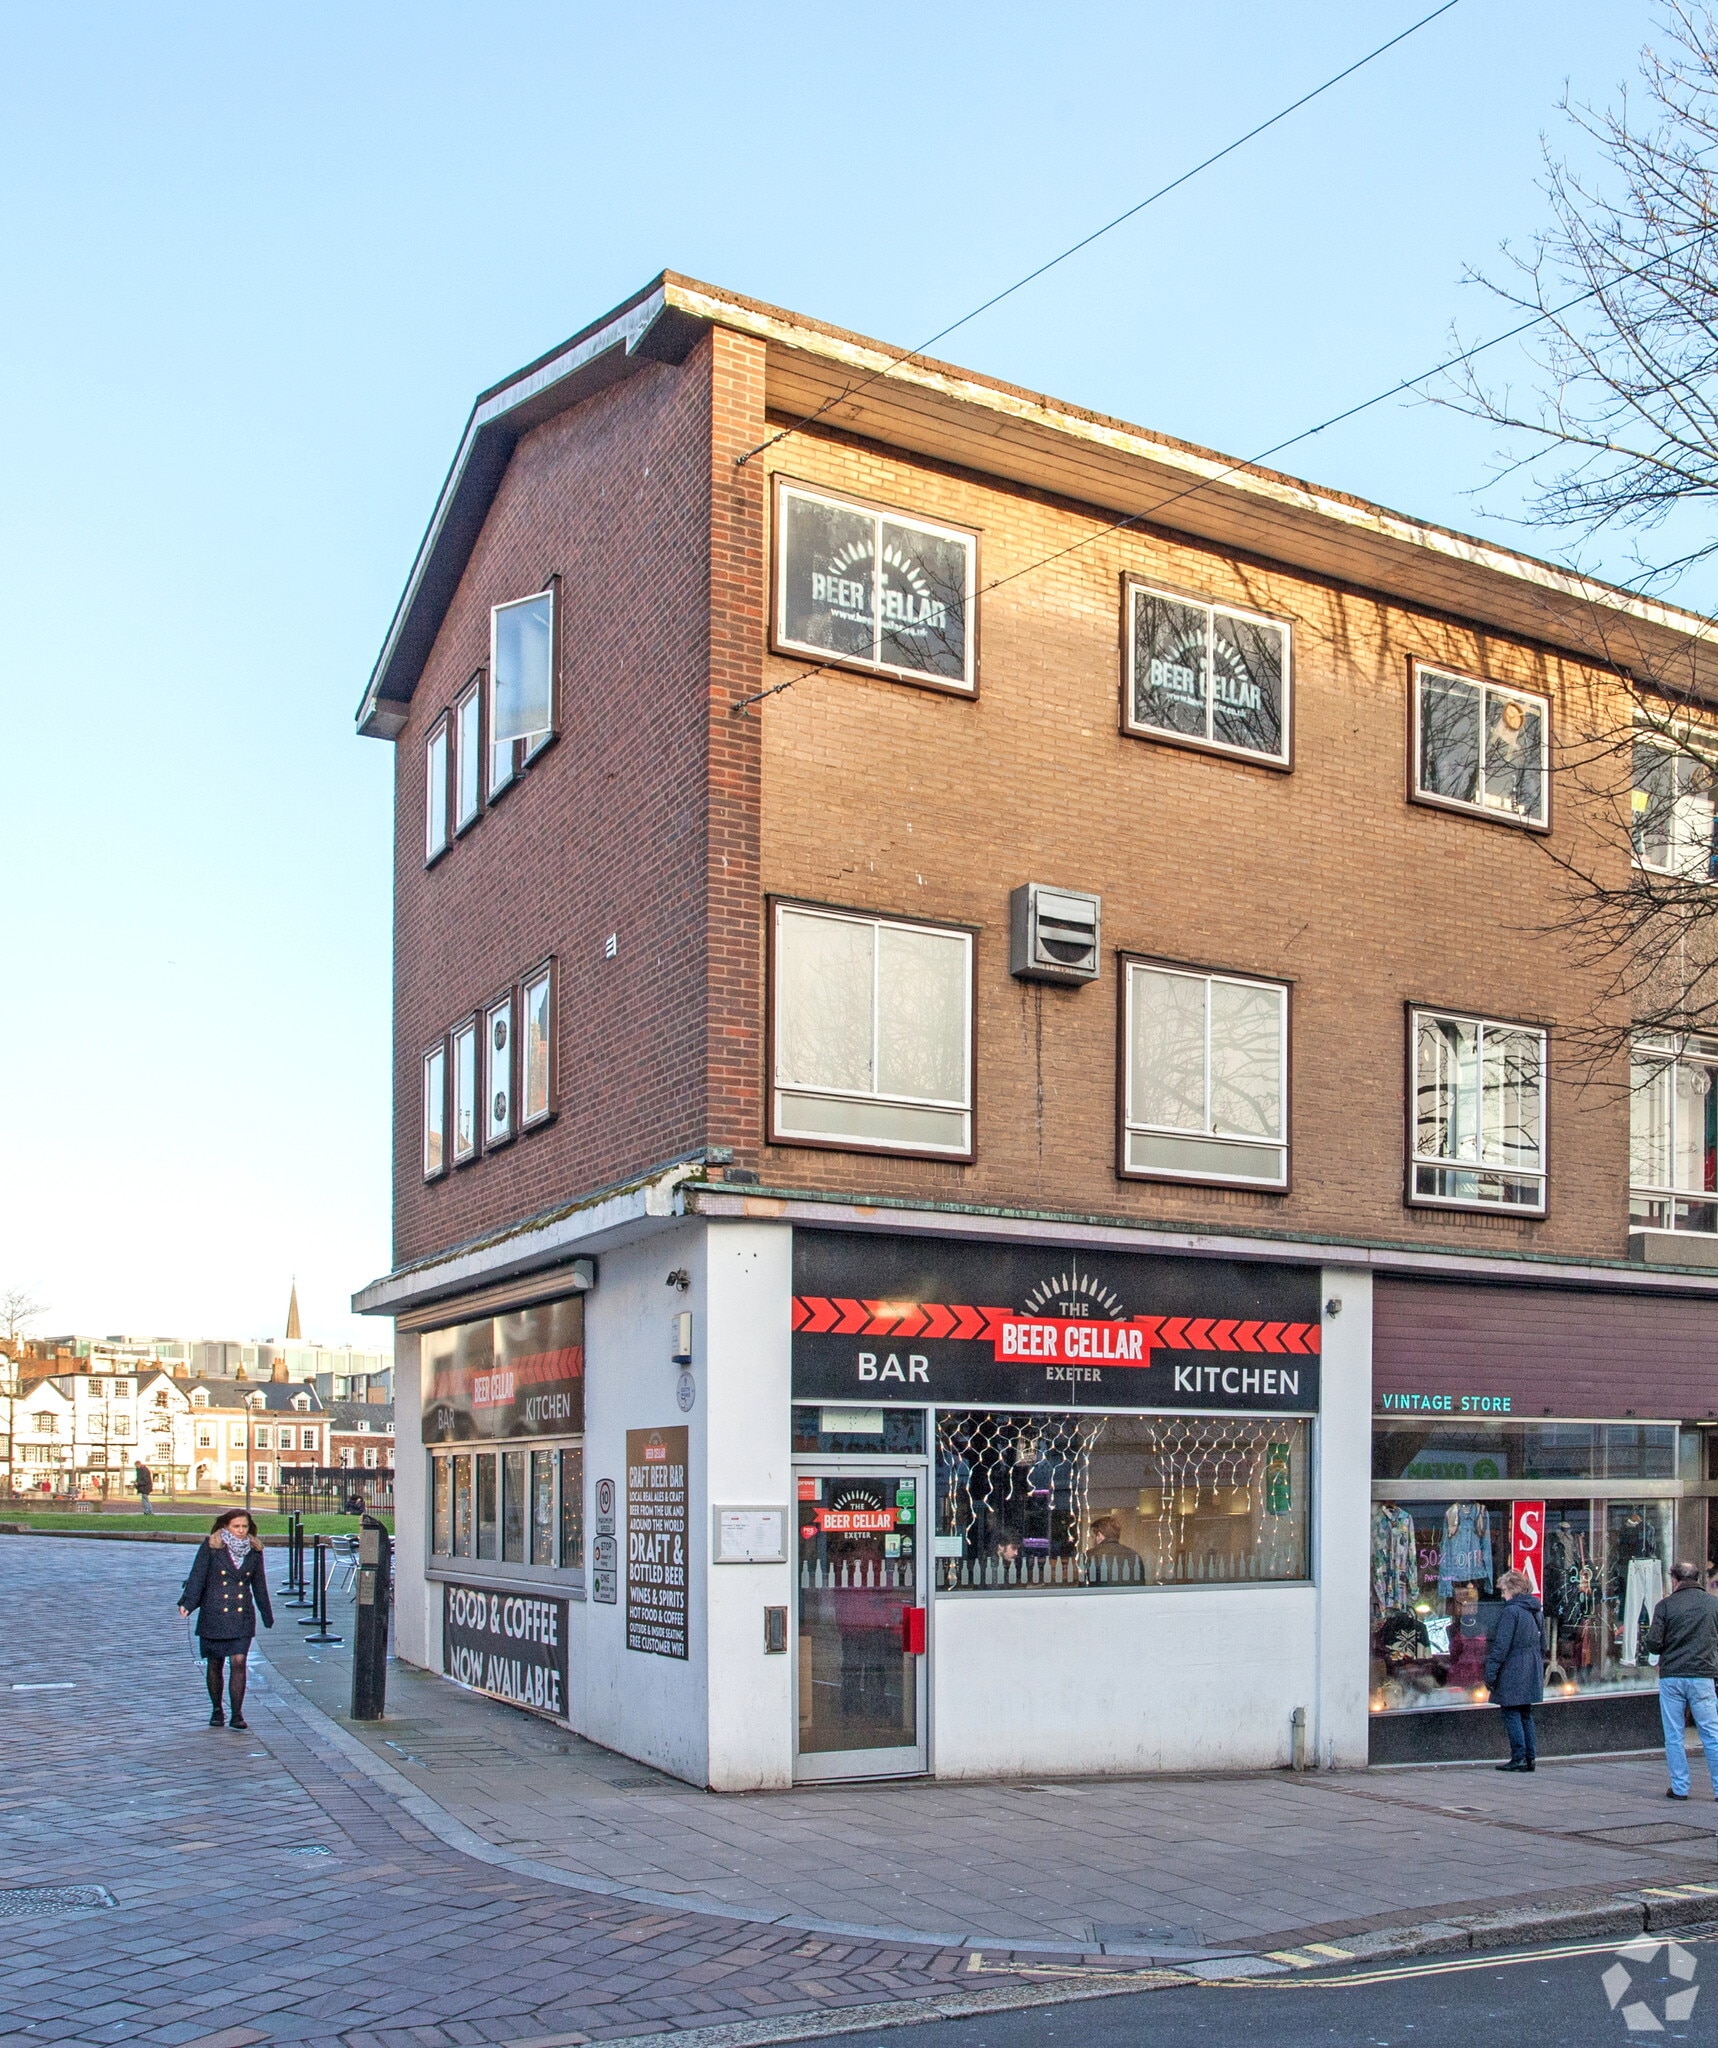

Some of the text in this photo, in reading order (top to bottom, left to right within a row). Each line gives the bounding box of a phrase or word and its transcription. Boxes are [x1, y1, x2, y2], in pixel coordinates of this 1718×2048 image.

[812, 572, 946, 629] BEER CELLAR
[1151, 658, 1262, 710] BEER CELLAR
[1059, 1302, 1089, 1317] THE
[1002, 1323, 1143, 1360] BEER CELLAR
[858, 1352, 930, 1383] BAR
[1046, 1367, 1102, 1382] EXETER
[475, 1372, 514, 1403] BEER CELLAR
[1174, 1365, 1300, 1395] KITCHEN
[526, 1393, 571, 1421] KITCHEN
[1383, 1394, 1511, 1412] VINTAGE STORE
[438, 1409, 455, 1430] BAR
[629, 1465, 684, 1488] CRAFT BEER BAR
[602, 1491, 609, 1505] 10
[630, 1491, 642, 1502] LOCAL
[643, 1491, 653, 1502] REAL
[654, 1491, 664, 1502] ALES
[669, 1491, 684, 1502] CRAFT
[630, 1505, 684, 1517] BEER FROM THE UK AND
[824, 1514, 890, 1528] BEER CELLAR
[630, 1519, 684, 1532] AROUND THE WORLD
[601, 1542, 612, 1551] STOP
[630, 1532, 670, 1563] DRAFT
[673, 1534, 684, 1565] &
[1420, 1548, 1447, 1569] 50%
[630, 1563, 684, 1586] BOTTLED BEER
[630, 1586, 684, 1609] WINES & SPIRITS
[449, 1587, 557, 1646] FOOD & COFFEE
[630, 1606, 684, 1626] HOT FOOD & COFFEE
[630, 1623, 647, 1635] OUTSIDE
[652, 1626, 665, 1638] INSIDE
[665, 1629, 684, 1641] SEATING
[630, 1635, 684, 1656] FREE CUSTOMER WIFI
[450, 1645, 560, 1713] NOW AVAILABLE
